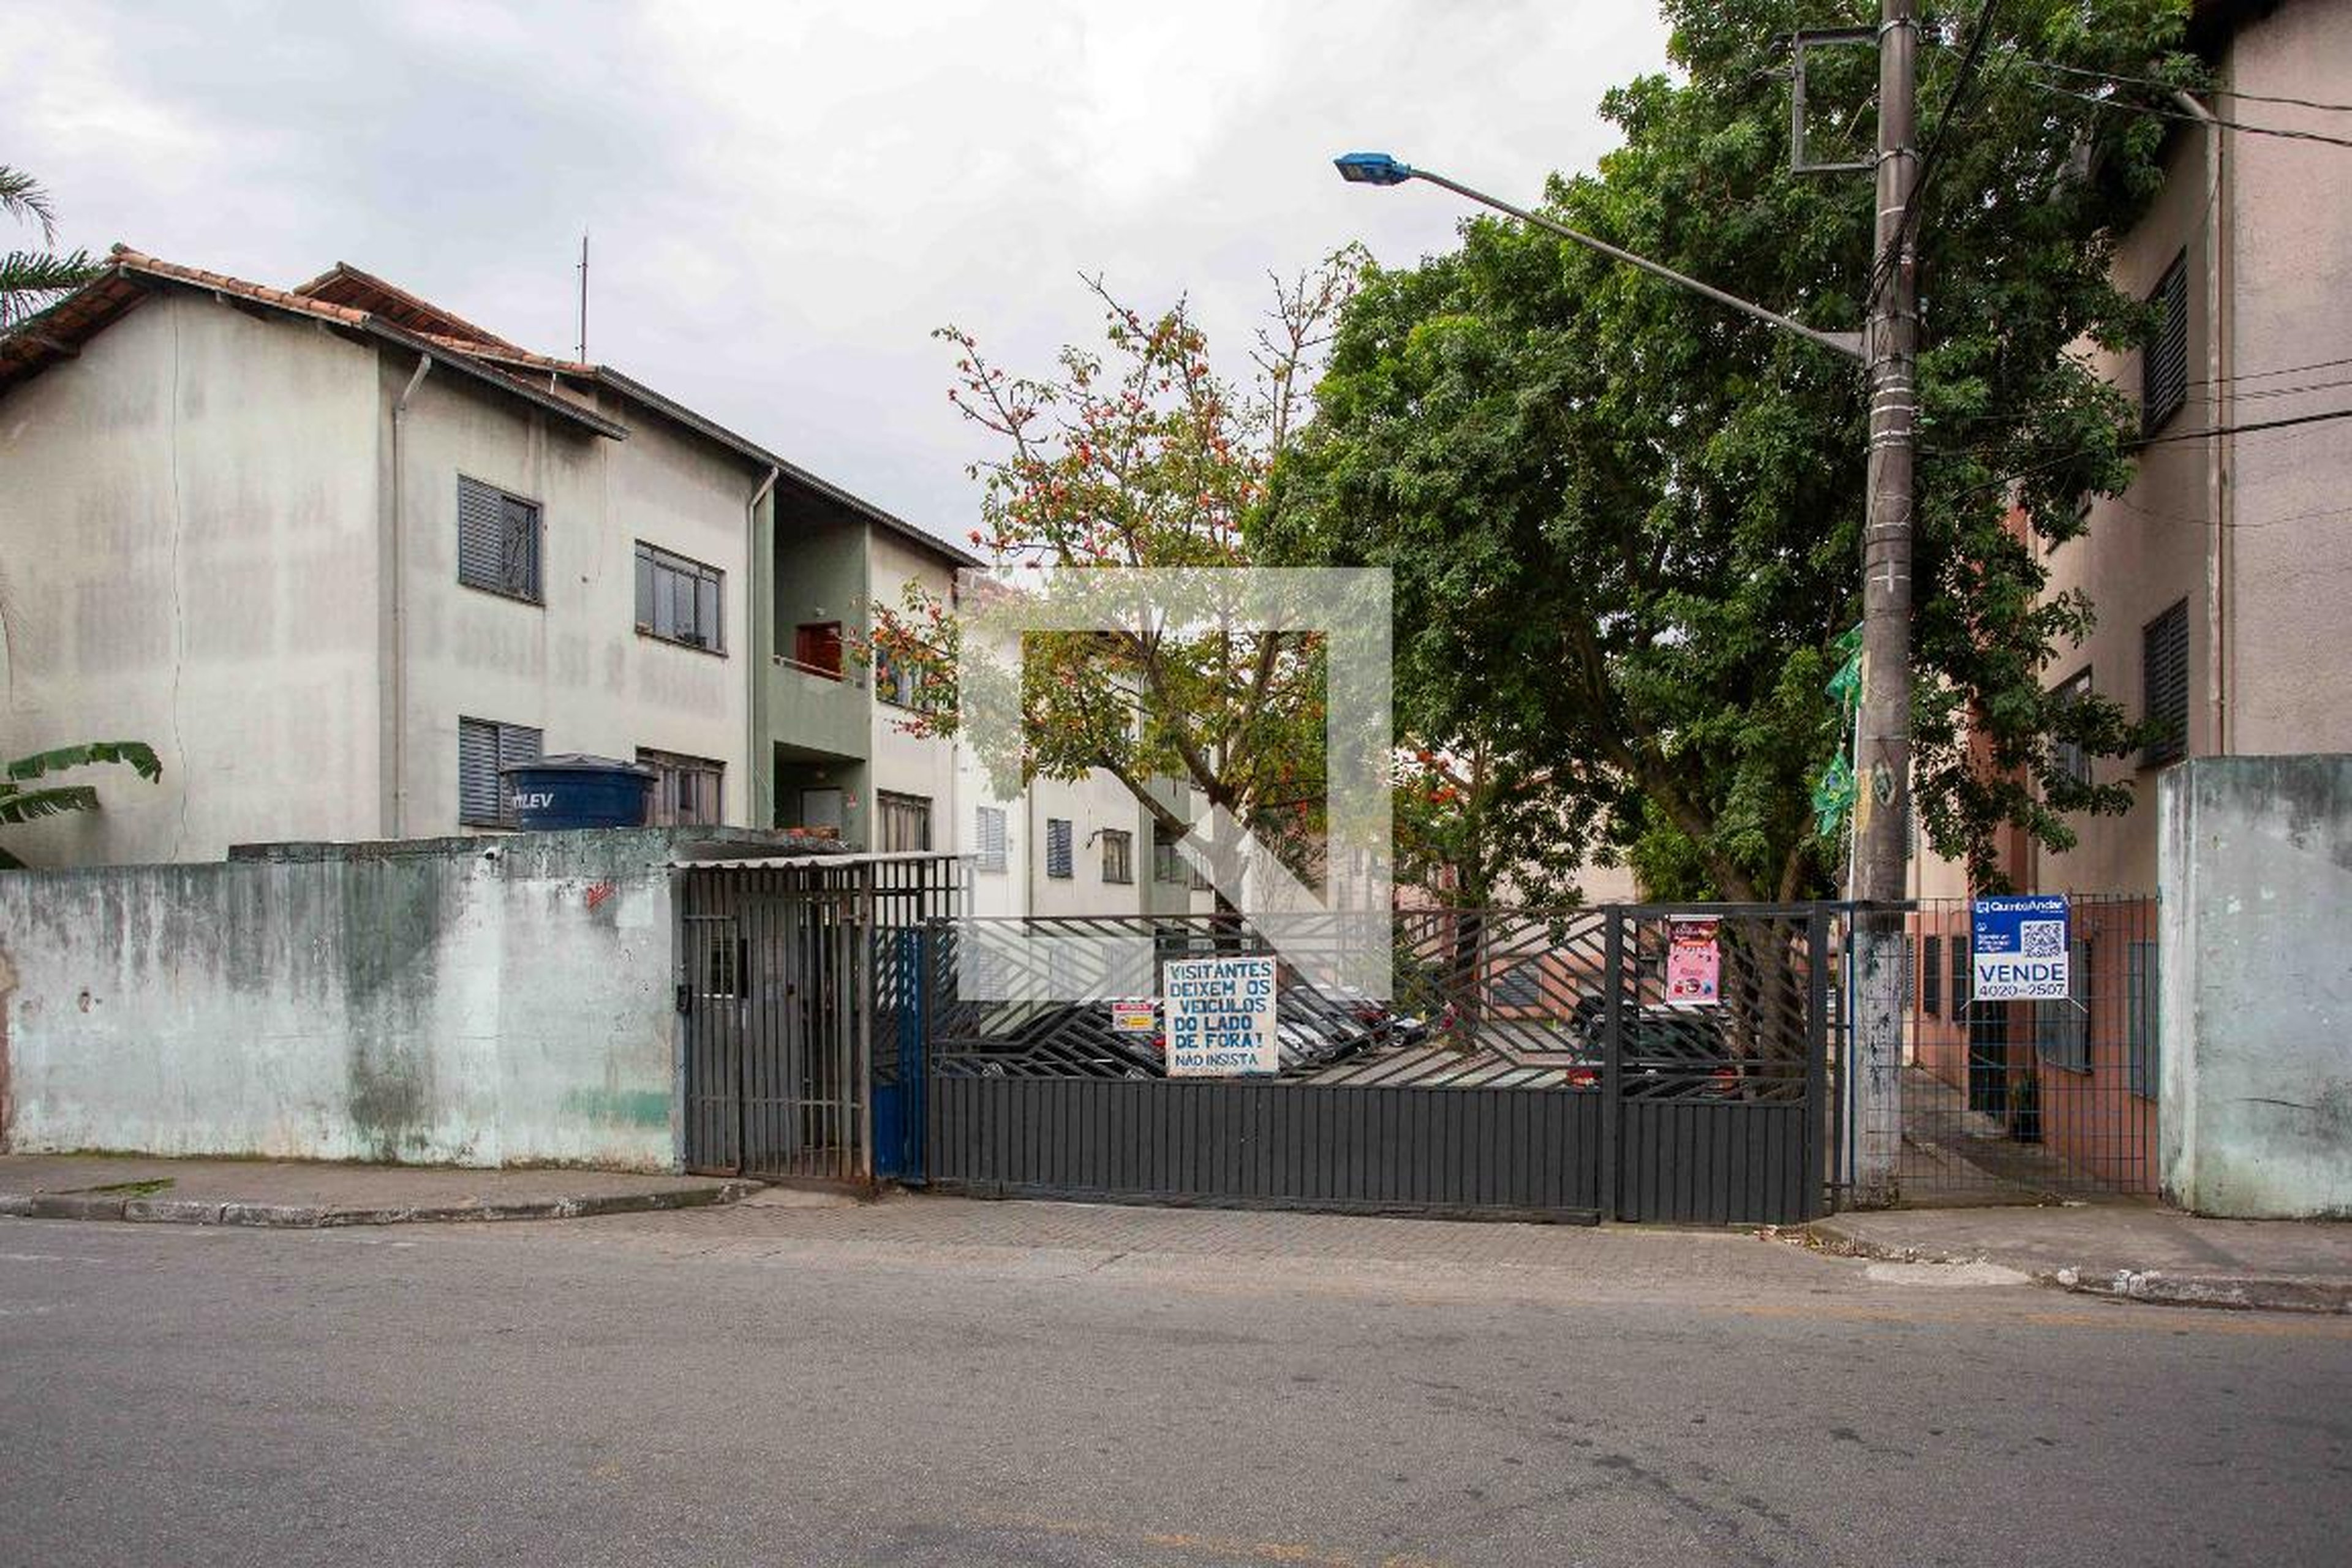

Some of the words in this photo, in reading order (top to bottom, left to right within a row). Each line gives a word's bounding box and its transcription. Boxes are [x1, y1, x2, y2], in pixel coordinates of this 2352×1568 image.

[1170, 962, 1272, 979] VISITANTES
[1979, 963, 2065, 982] VENDE
[1170, 981, 1236, 997] DEIXEM
[1247, 980, 1270, 995] OS
[1175, 1017, 1197, 1031] DO
[1205, 1015, 1252, 1031] LADO
[1175, 1034, 1199, 1048] DE
[1206, 1033, 1263, 1048] FORA!
